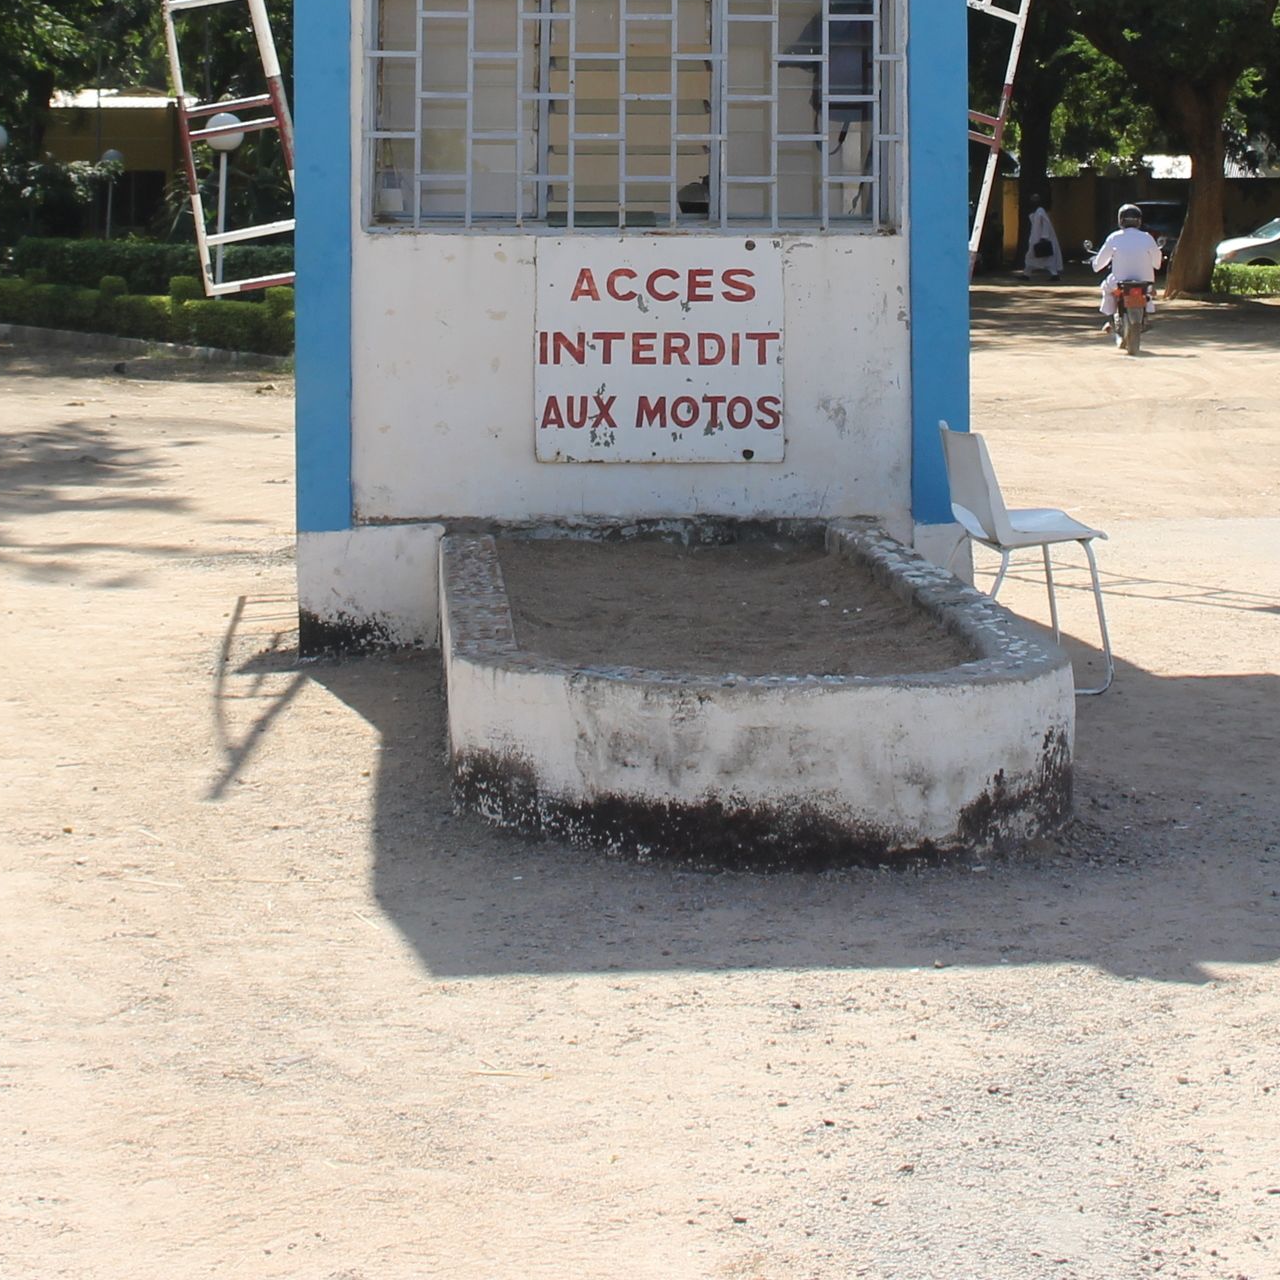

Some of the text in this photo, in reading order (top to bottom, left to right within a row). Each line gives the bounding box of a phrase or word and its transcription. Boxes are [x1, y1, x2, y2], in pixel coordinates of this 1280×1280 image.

[570, 268, 756, 302] ACCES
[539, 331, 780, 366] INTERDIT
[540, 395, 782, 430] AUX MOTOS
